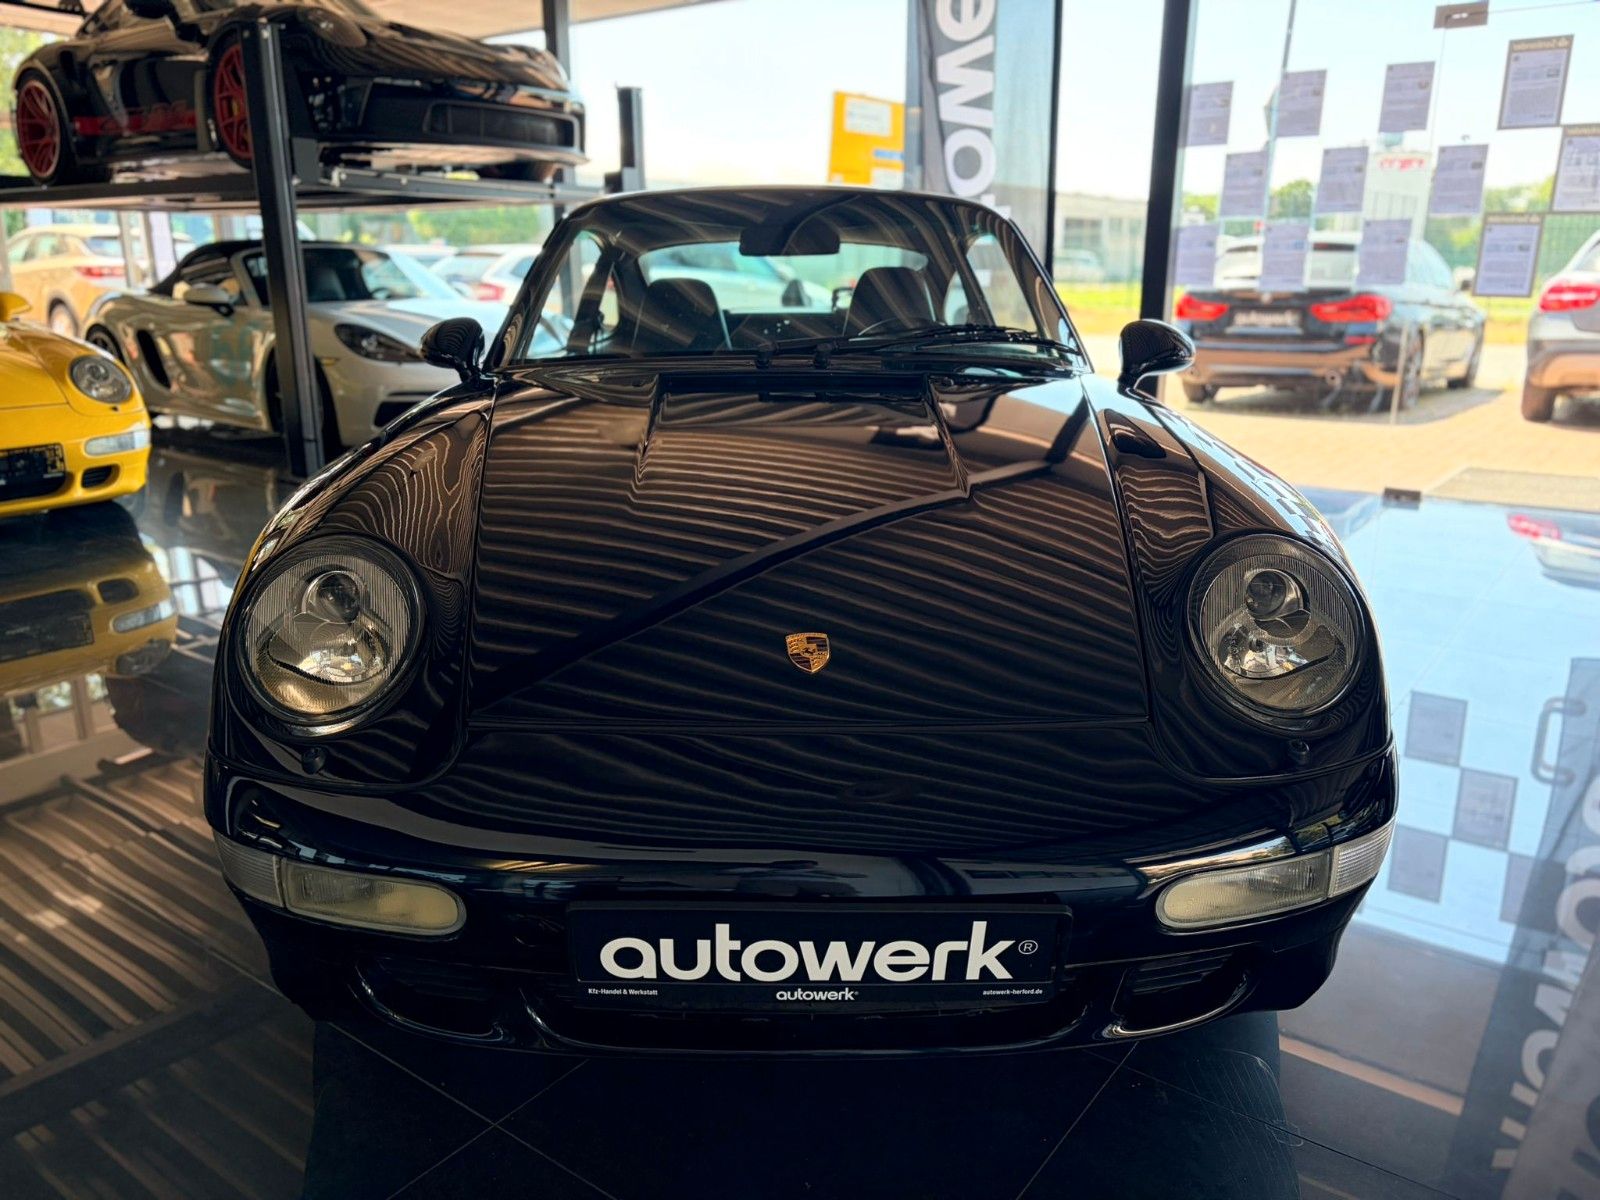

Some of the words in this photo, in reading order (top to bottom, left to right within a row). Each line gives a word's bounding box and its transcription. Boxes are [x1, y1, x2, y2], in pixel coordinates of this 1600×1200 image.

[600, 921, 1016, 982] autowerk
[776, 987, 855, 1001] autowerk
[982, 988, 1043, 996] autowerk-herford.de
